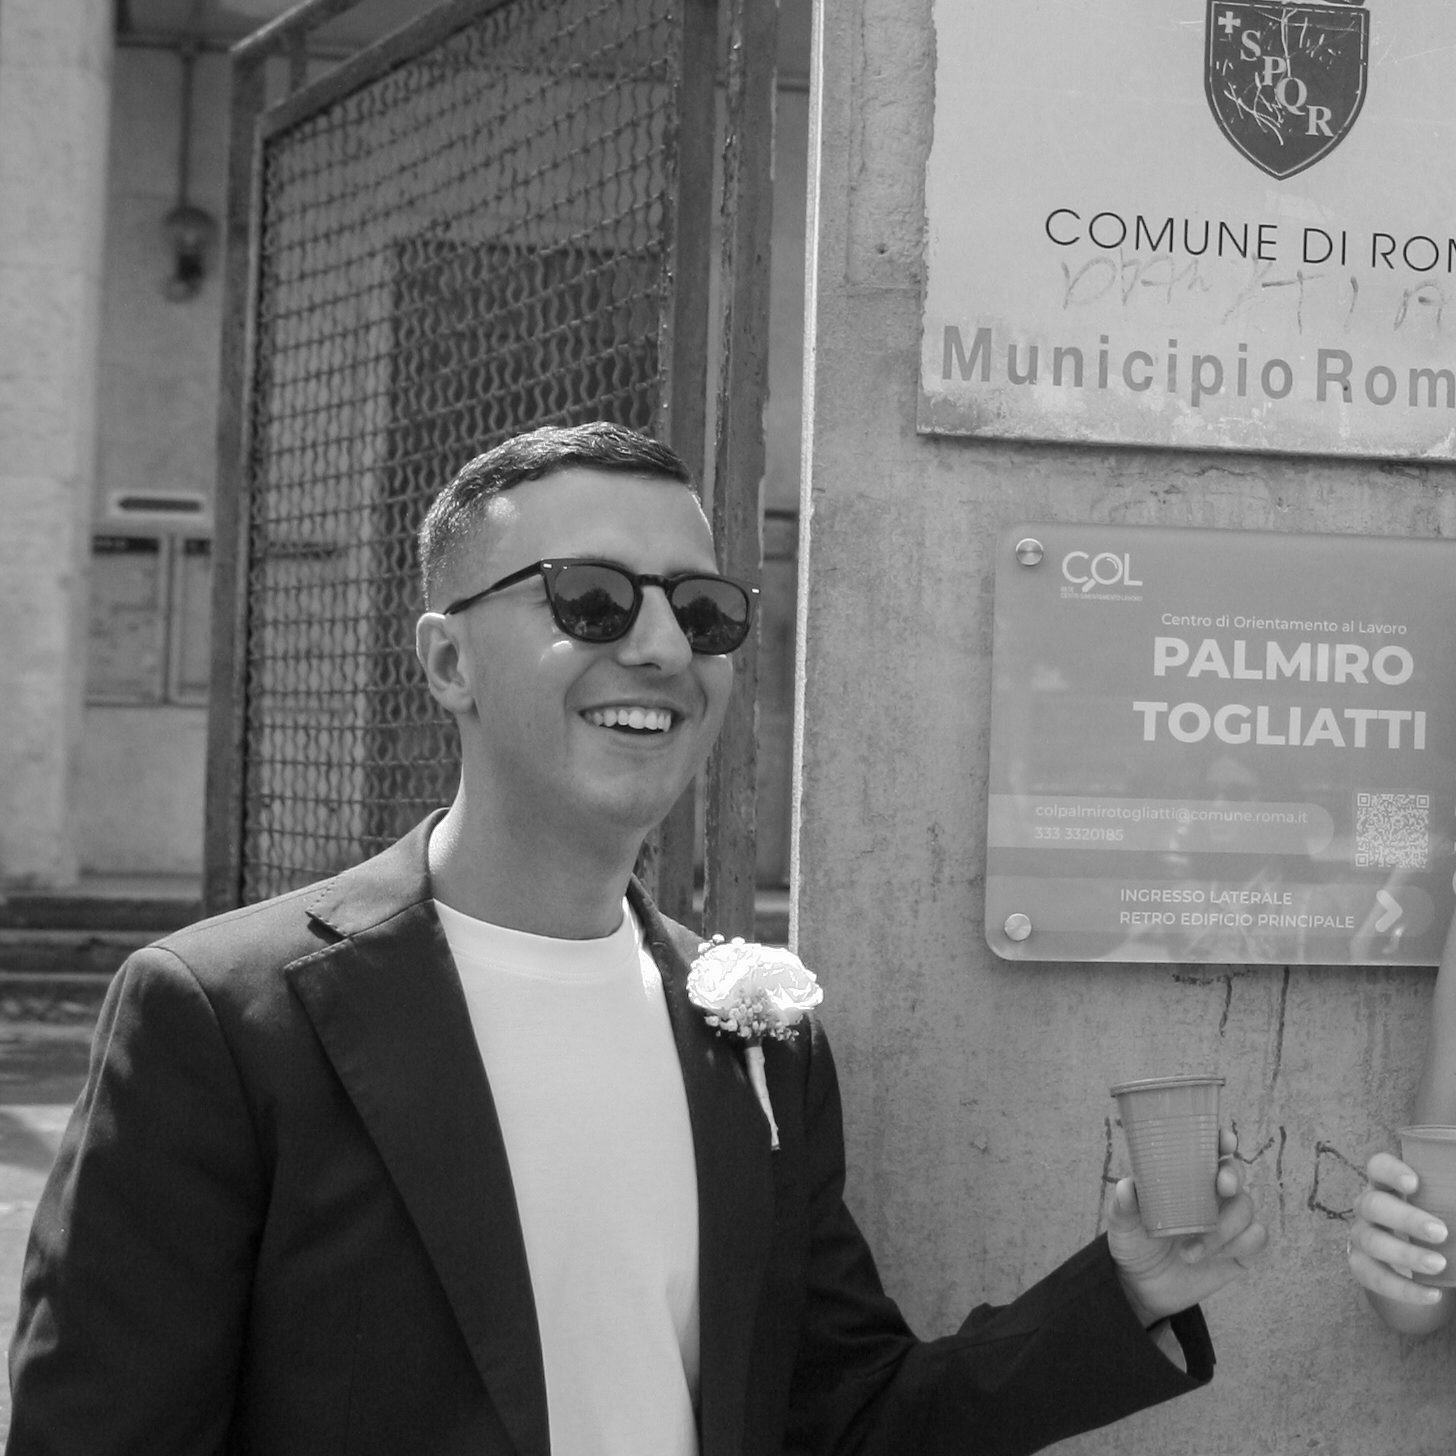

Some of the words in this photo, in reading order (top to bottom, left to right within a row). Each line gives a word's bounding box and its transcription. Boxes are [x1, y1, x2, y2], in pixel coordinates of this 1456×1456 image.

[1045, 208, 1278, 262] COMUNE
[1303, 227, 1347, 266] DI
[942, 325, 1294, 408] Municipio
[1062, 550, 1143, 593] COL
[1161, 613, 1212, 627] Centro
[1215, 614, 1230, 628] di
[1233, 616, 1338, 633] Orientamento
[1341, 620, 1355, 633] al
[1358, 621, 1408, 635] Lavoro
[1153, 636, 1414, 686] PALMIRO
[1132, 701, 1427, 750] TOGLIATTI
[1035, 804, 1309, 824] colpalmirotogliatti@comune.roma.it
[1034, 827, 1060, 841] 333
[1064, 827, 1124, 842] 3320185
[1120, 888, 1206, 904] INGRESSO
[1210, 890, 1293, 906] LATERALE
[1119, 911, 1176, 926] RETRO
[1181, 913, 1254, 927] EDIFICIO
[1258, 914, 1355, 929] PRINCIPALE
